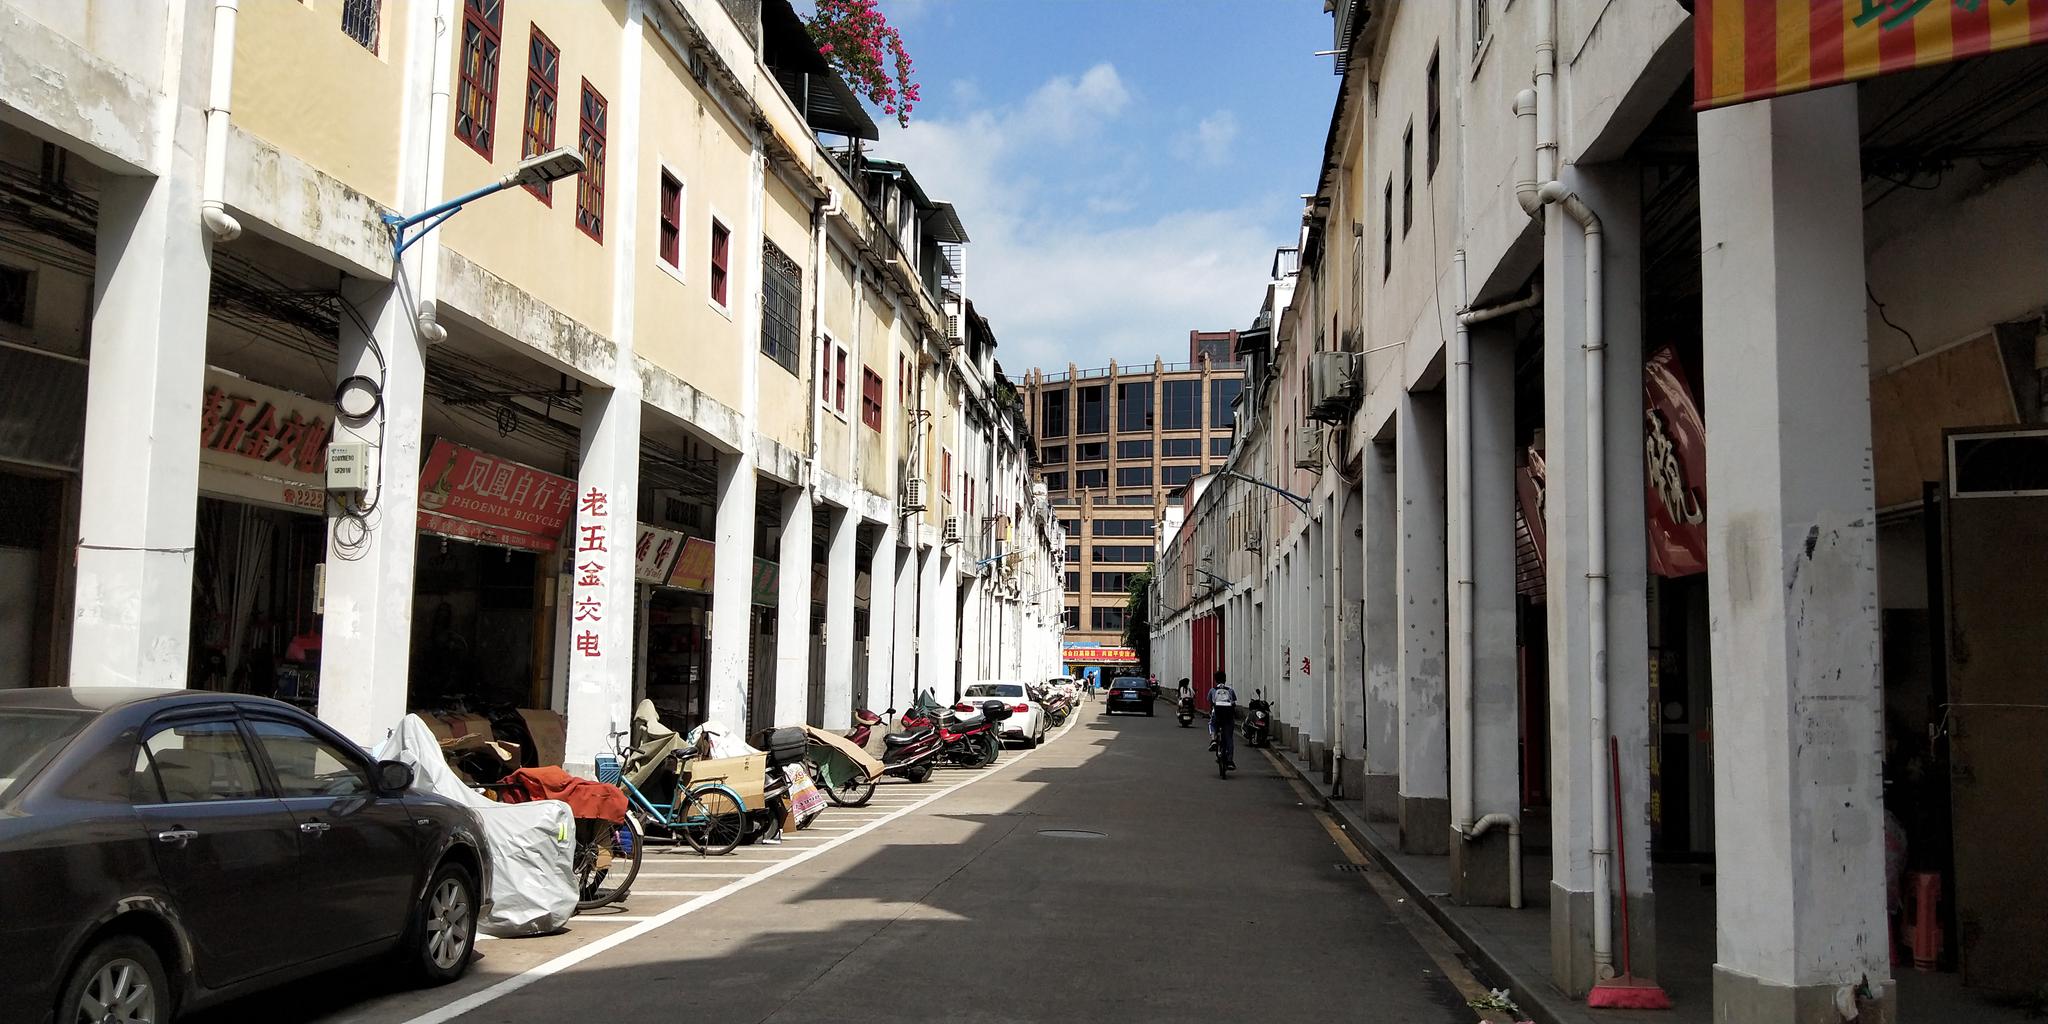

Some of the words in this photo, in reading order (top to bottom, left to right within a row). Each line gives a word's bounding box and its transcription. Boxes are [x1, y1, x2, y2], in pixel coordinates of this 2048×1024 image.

[452, 495, 510, 517] PHOENIX
[514, 511, 562, 528] BICYCLE
[457, 455, 576, 514] 凤凰自行车
[574, 487, 608, 657] 老五金交电
